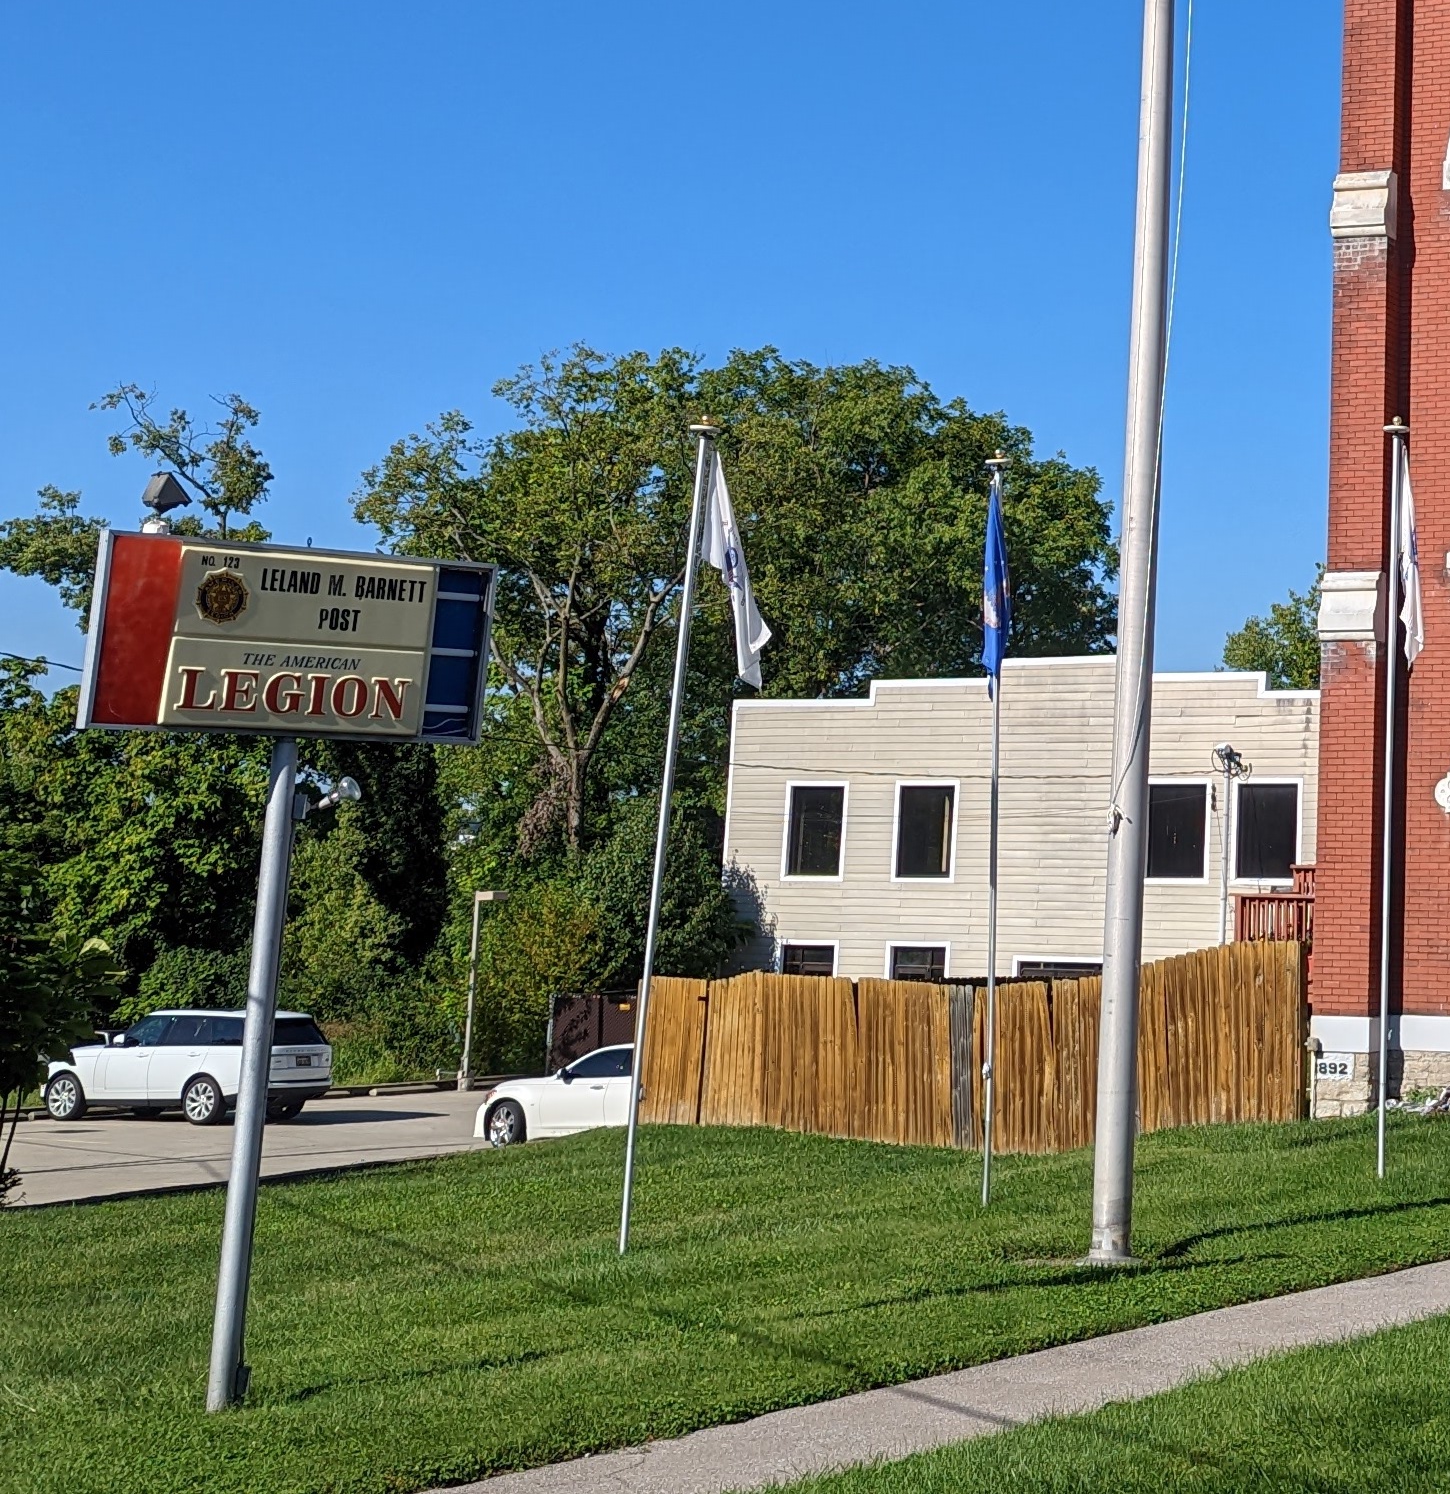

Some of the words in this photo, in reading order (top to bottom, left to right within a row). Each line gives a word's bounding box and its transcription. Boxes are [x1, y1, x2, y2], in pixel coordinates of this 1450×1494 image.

[223, 555, 241, 569] 123
[260, 567, 321, 596] LELAND
[327, 574, 347, 597] M.
[354, 576, 428, 604] BARNETT
[318, 608, 361, 633] POST
[242, 652, 276, 667] THE
[279, 655, 361, 671] AMERICAN
[174, 666, 413, 721] LEGION
